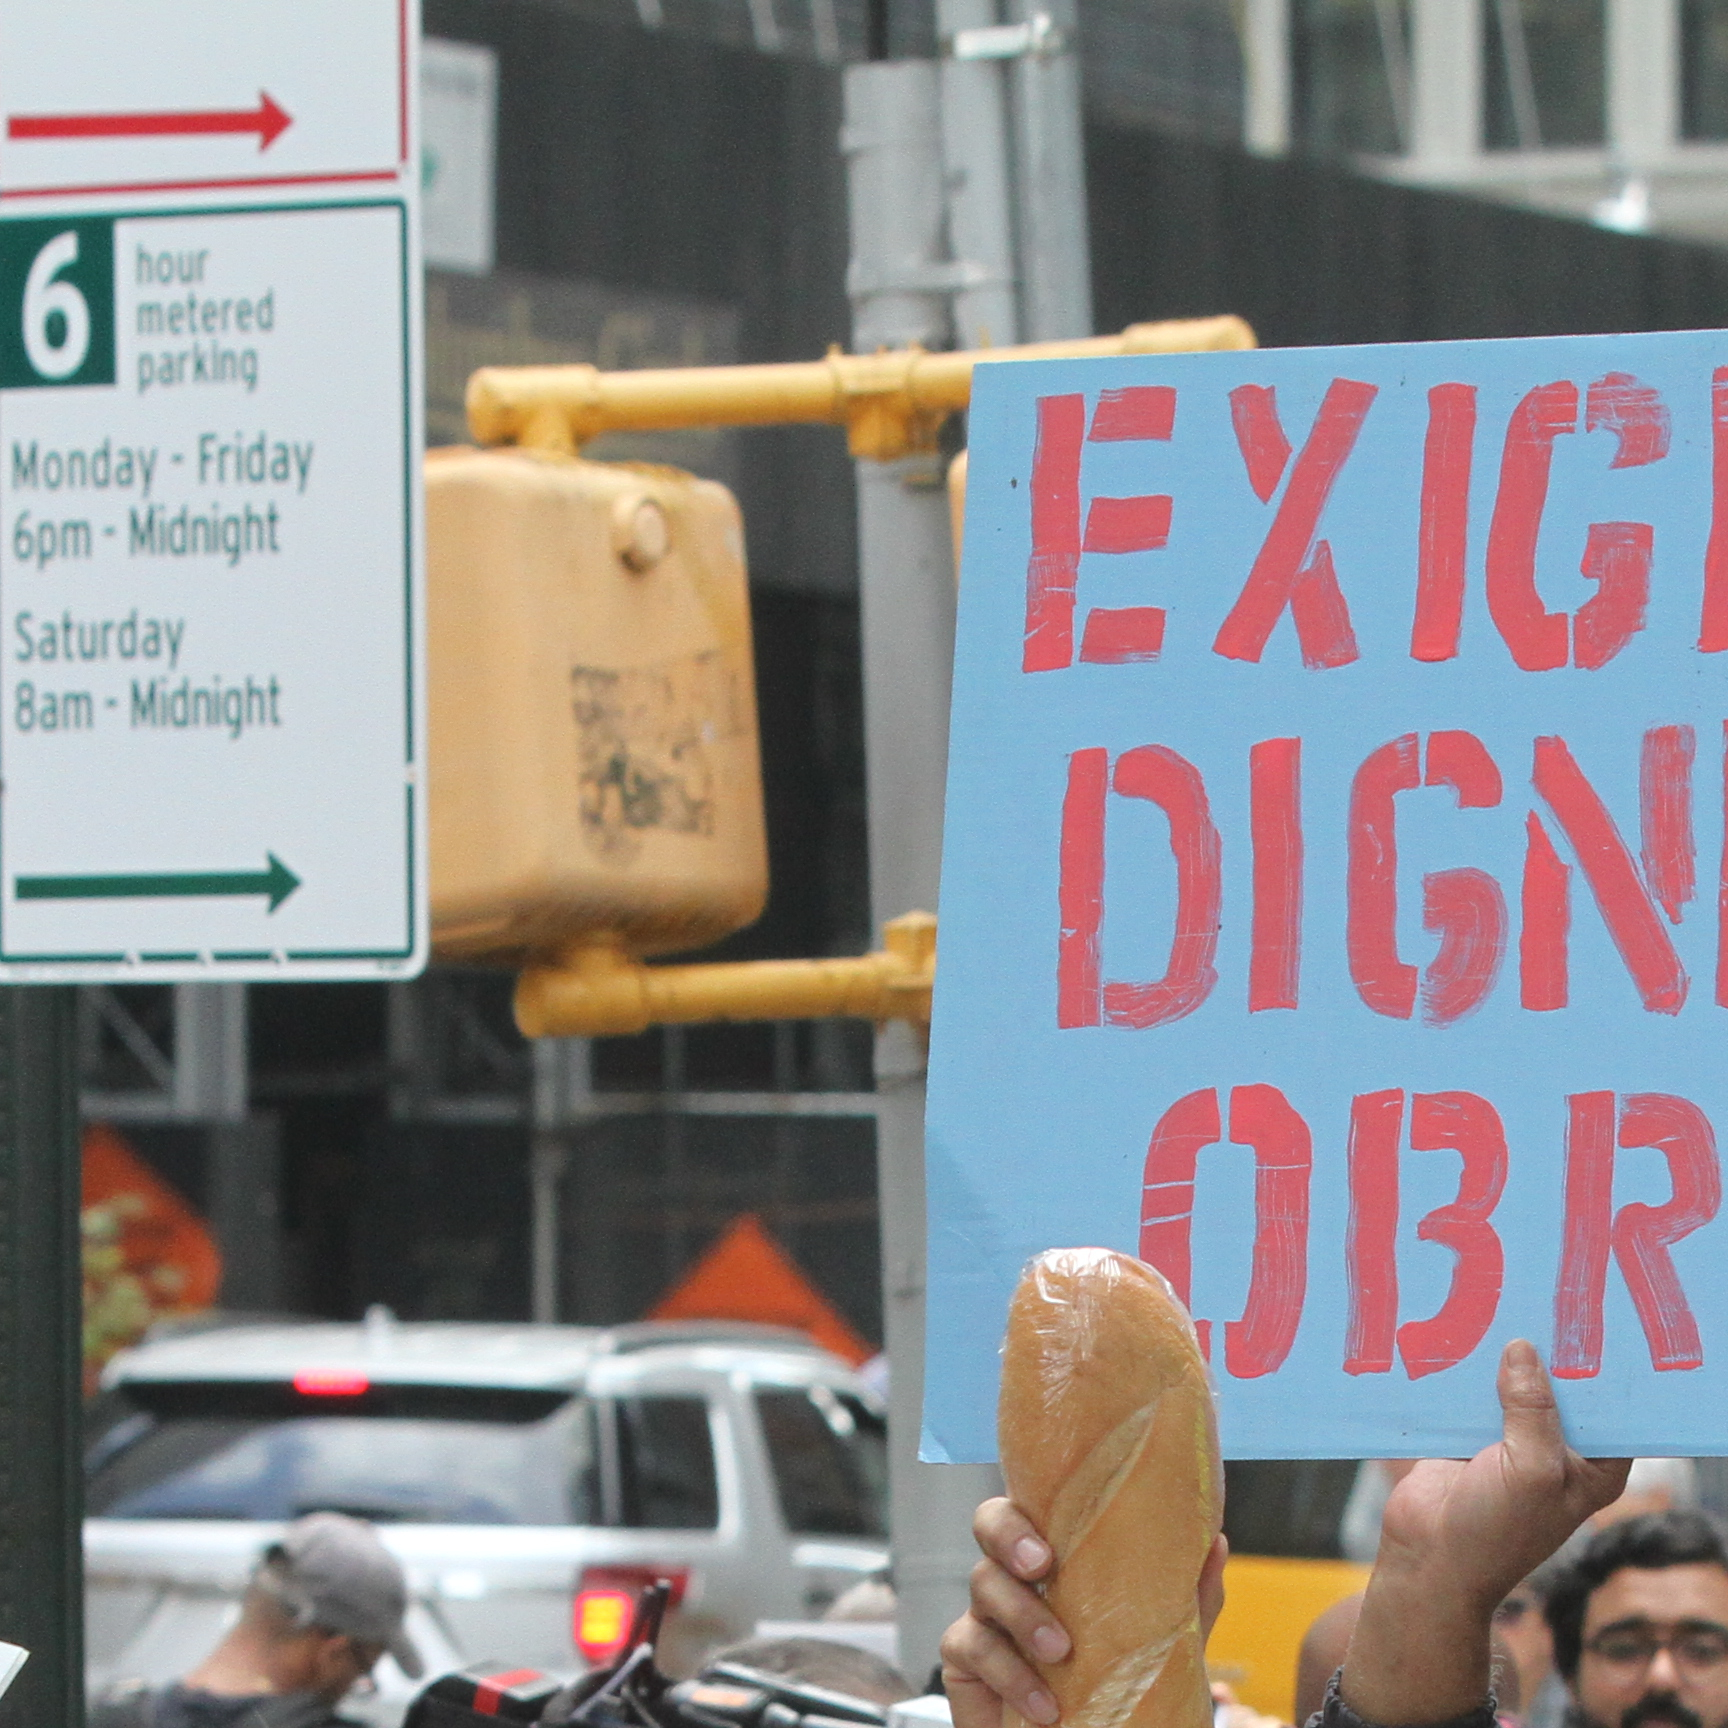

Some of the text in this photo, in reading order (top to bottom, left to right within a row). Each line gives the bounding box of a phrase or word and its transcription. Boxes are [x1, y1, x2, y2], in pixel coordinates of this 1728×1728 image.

[135, 243, 209, 284] hour
[22, 230, 91, 380] 6
[136, 288, 275, 335] metered
[137, 340, 259, 395] parking
[12, 436, 158, 498] Monday
[198, 430, 313, 495] Friday
[13, 510, 92, 571] 6pm
[129, 501, 281, 568] Midnight
[15, 606, 185, 672] Saturday
[15, 679, 94, 732] 8am
[130, 673, 282, 741] Midnight
